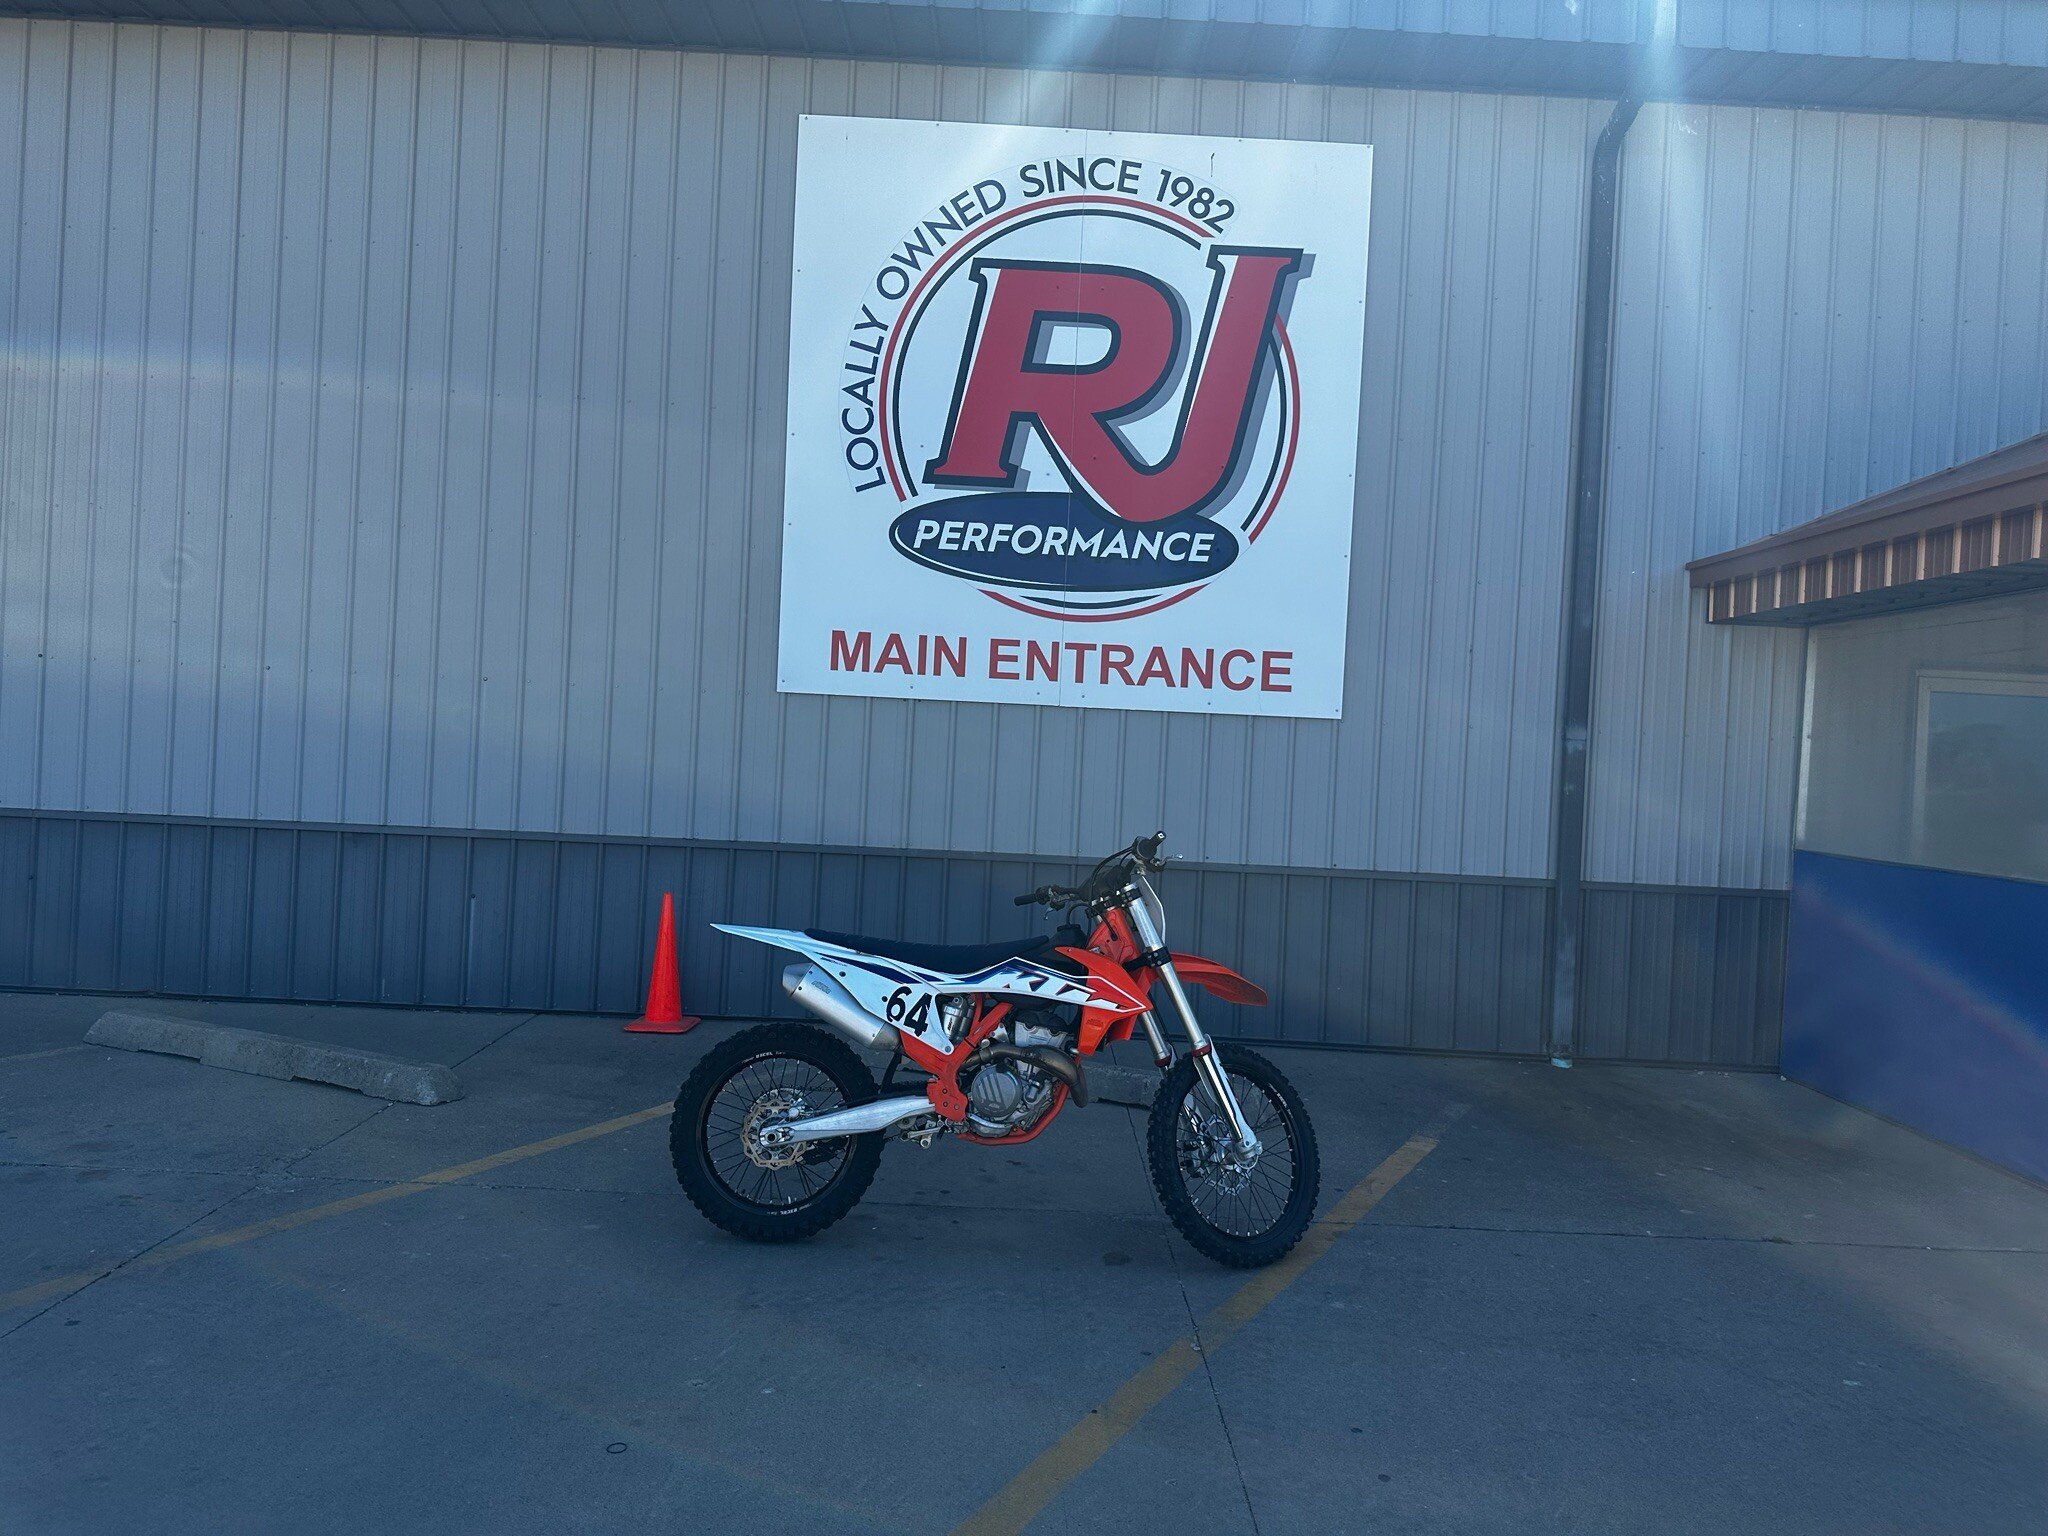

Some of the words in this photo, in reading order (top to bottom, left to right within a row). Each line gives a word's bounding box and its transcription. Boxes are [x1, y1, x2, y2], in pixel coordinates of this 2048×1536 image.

[841, 303, 890, 493] LOCALLY
[876, 179, 1007, 301] OWNED
[1019, 157, 1143, 198] SINCE
[1156, 169, 1235, 235] 1982
[923, 245, 1304, 523] RJ
[913, 518, 1216, 563] PERFORMANCE
[830, 629, 968, 678] MAIN
[988, 638, 1293, 693] ENTRANCE
[886, 986, 933, 1037] 64
